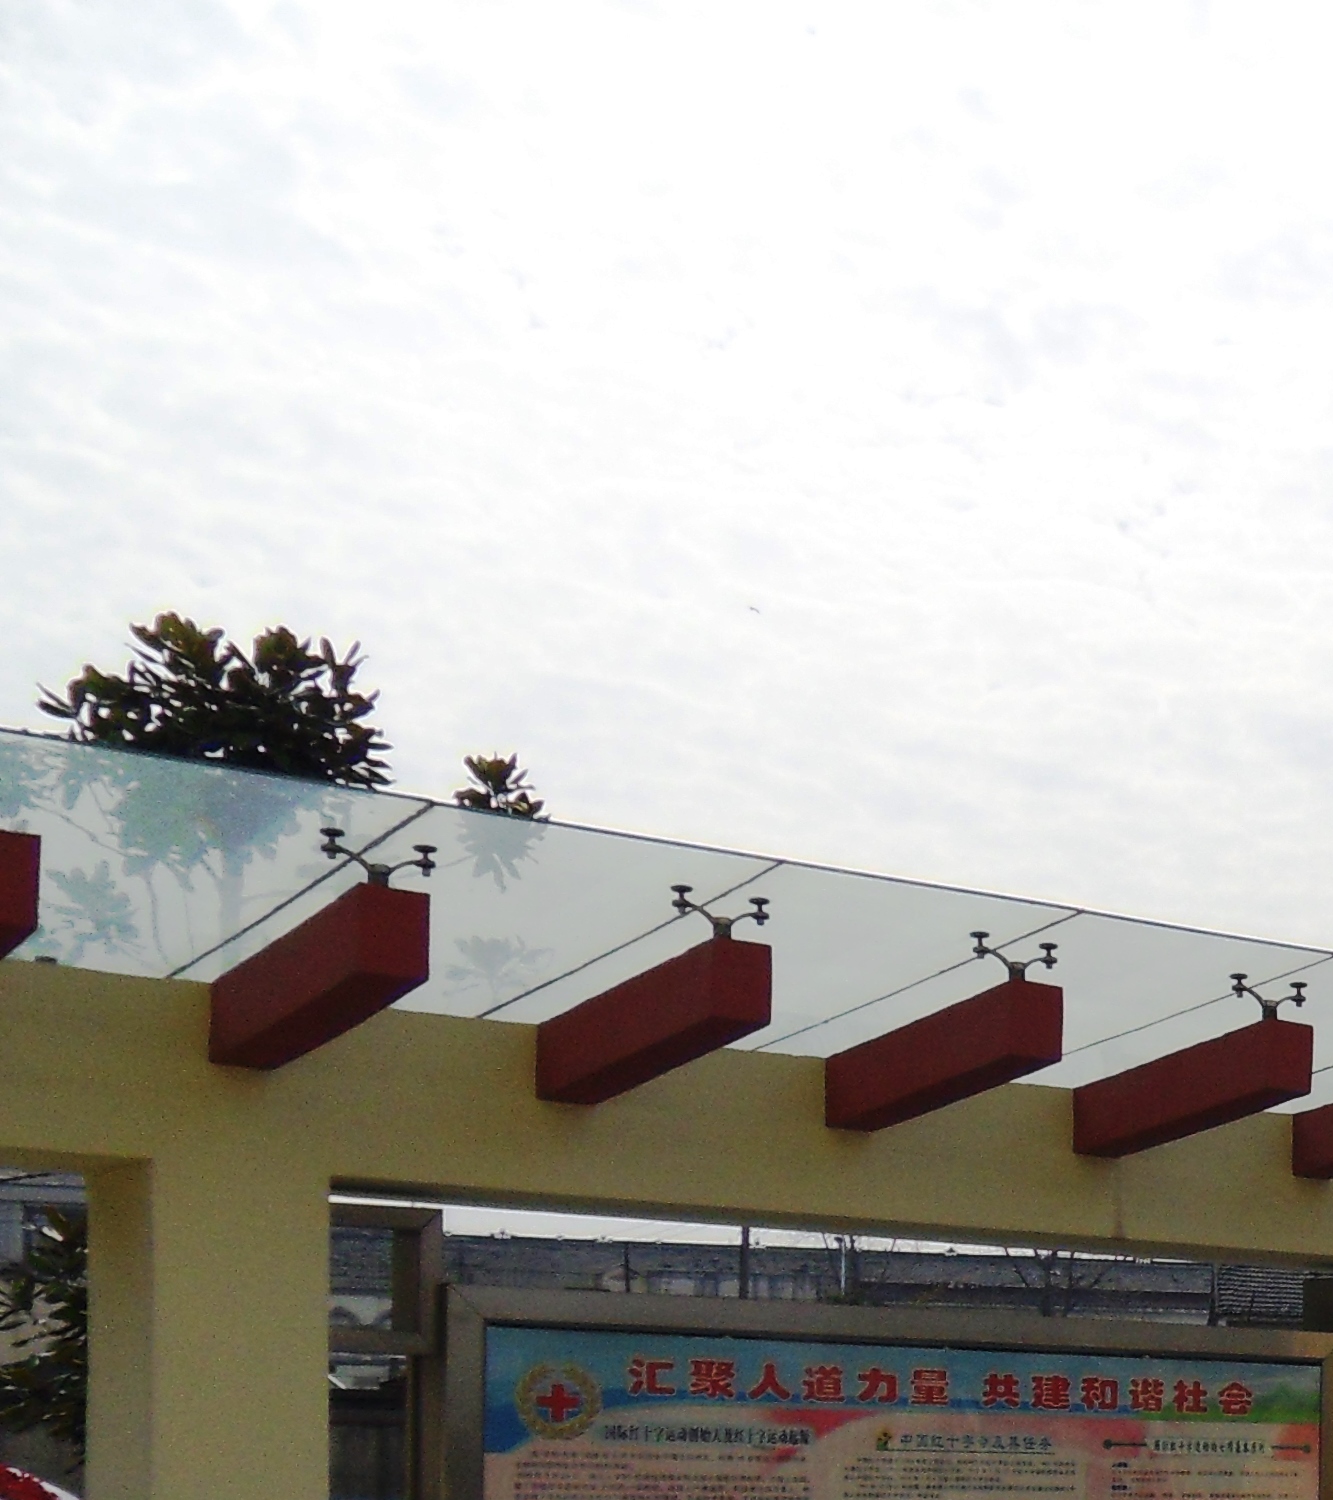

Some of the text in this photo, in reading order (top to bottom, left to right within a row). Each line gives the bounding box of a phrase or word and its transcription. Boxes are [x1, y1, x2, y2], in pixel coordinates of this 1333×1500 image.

[628, 1358, 1253, 1415] 汇聚人道力量 共建和谐社会
